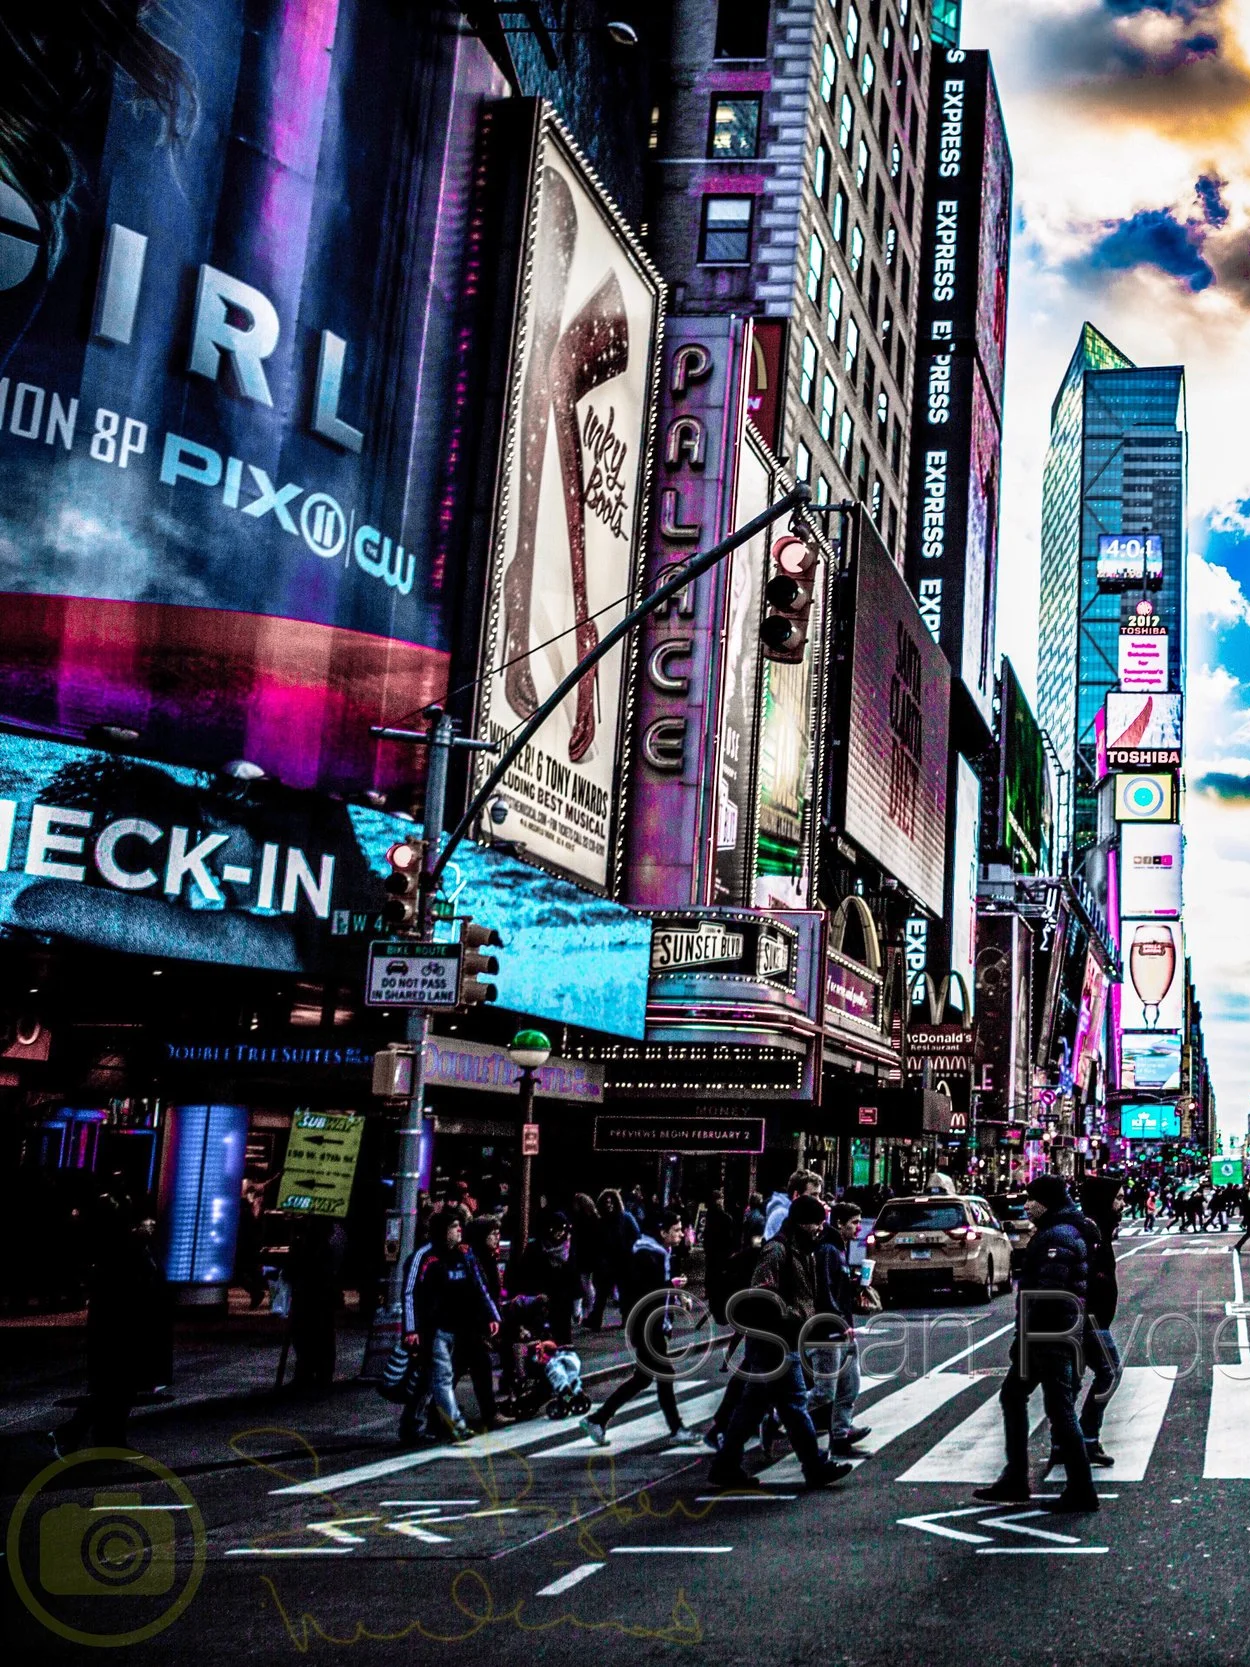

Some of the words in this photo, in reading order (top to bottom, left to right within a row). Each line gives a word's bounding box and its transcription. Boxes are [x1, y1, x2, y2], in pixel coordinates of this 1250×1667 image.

[939, 79, 965, 178] EXPRESS
[933, 200, 958, 302] EXPRESS
[90, 407, 148, 469] 8P
[922, 450, 948, 559] EXPRESS
[642, 342, 712, 772] PALACE
[1128, 615, 1160, 626] 2017
[1121, 627, 1166, 635] TOSHIBA
[1107, 750, 1180, 764] TOSHIBA
[536, 750, 543, 782] 6
[545, 755, 572, 798] TONY
[572, 773, 609, 820] AWARDS
[537, 786, 563, 815] BEST
[565, 803, 606, 839] MUSICAL
[353, 914, 367, 932] W
[387, 946, 408, 954] BIKE
[416, 946, 446, 955] ROUTE
[660, 934, 718, 966] SUNSET
[381, 978, 395, 989] DO
[399, 978, 418, 989] NOT
[422, 978, 447, 989] PASS
[372, 990, 383, 1000] IN
[385, 990, 426, 1001] SHARED
[428, 991, 454, 1001] LANE
[297, 1114, 360, 1133] SUBWAY
[659, 1129, 690, 1139] BEGIN
[691, 1129, 741, 1140] FEBRUARY
[741, 1129, 751, 1140] 2
[281, 1195, 345, 1213] SUBWAY
